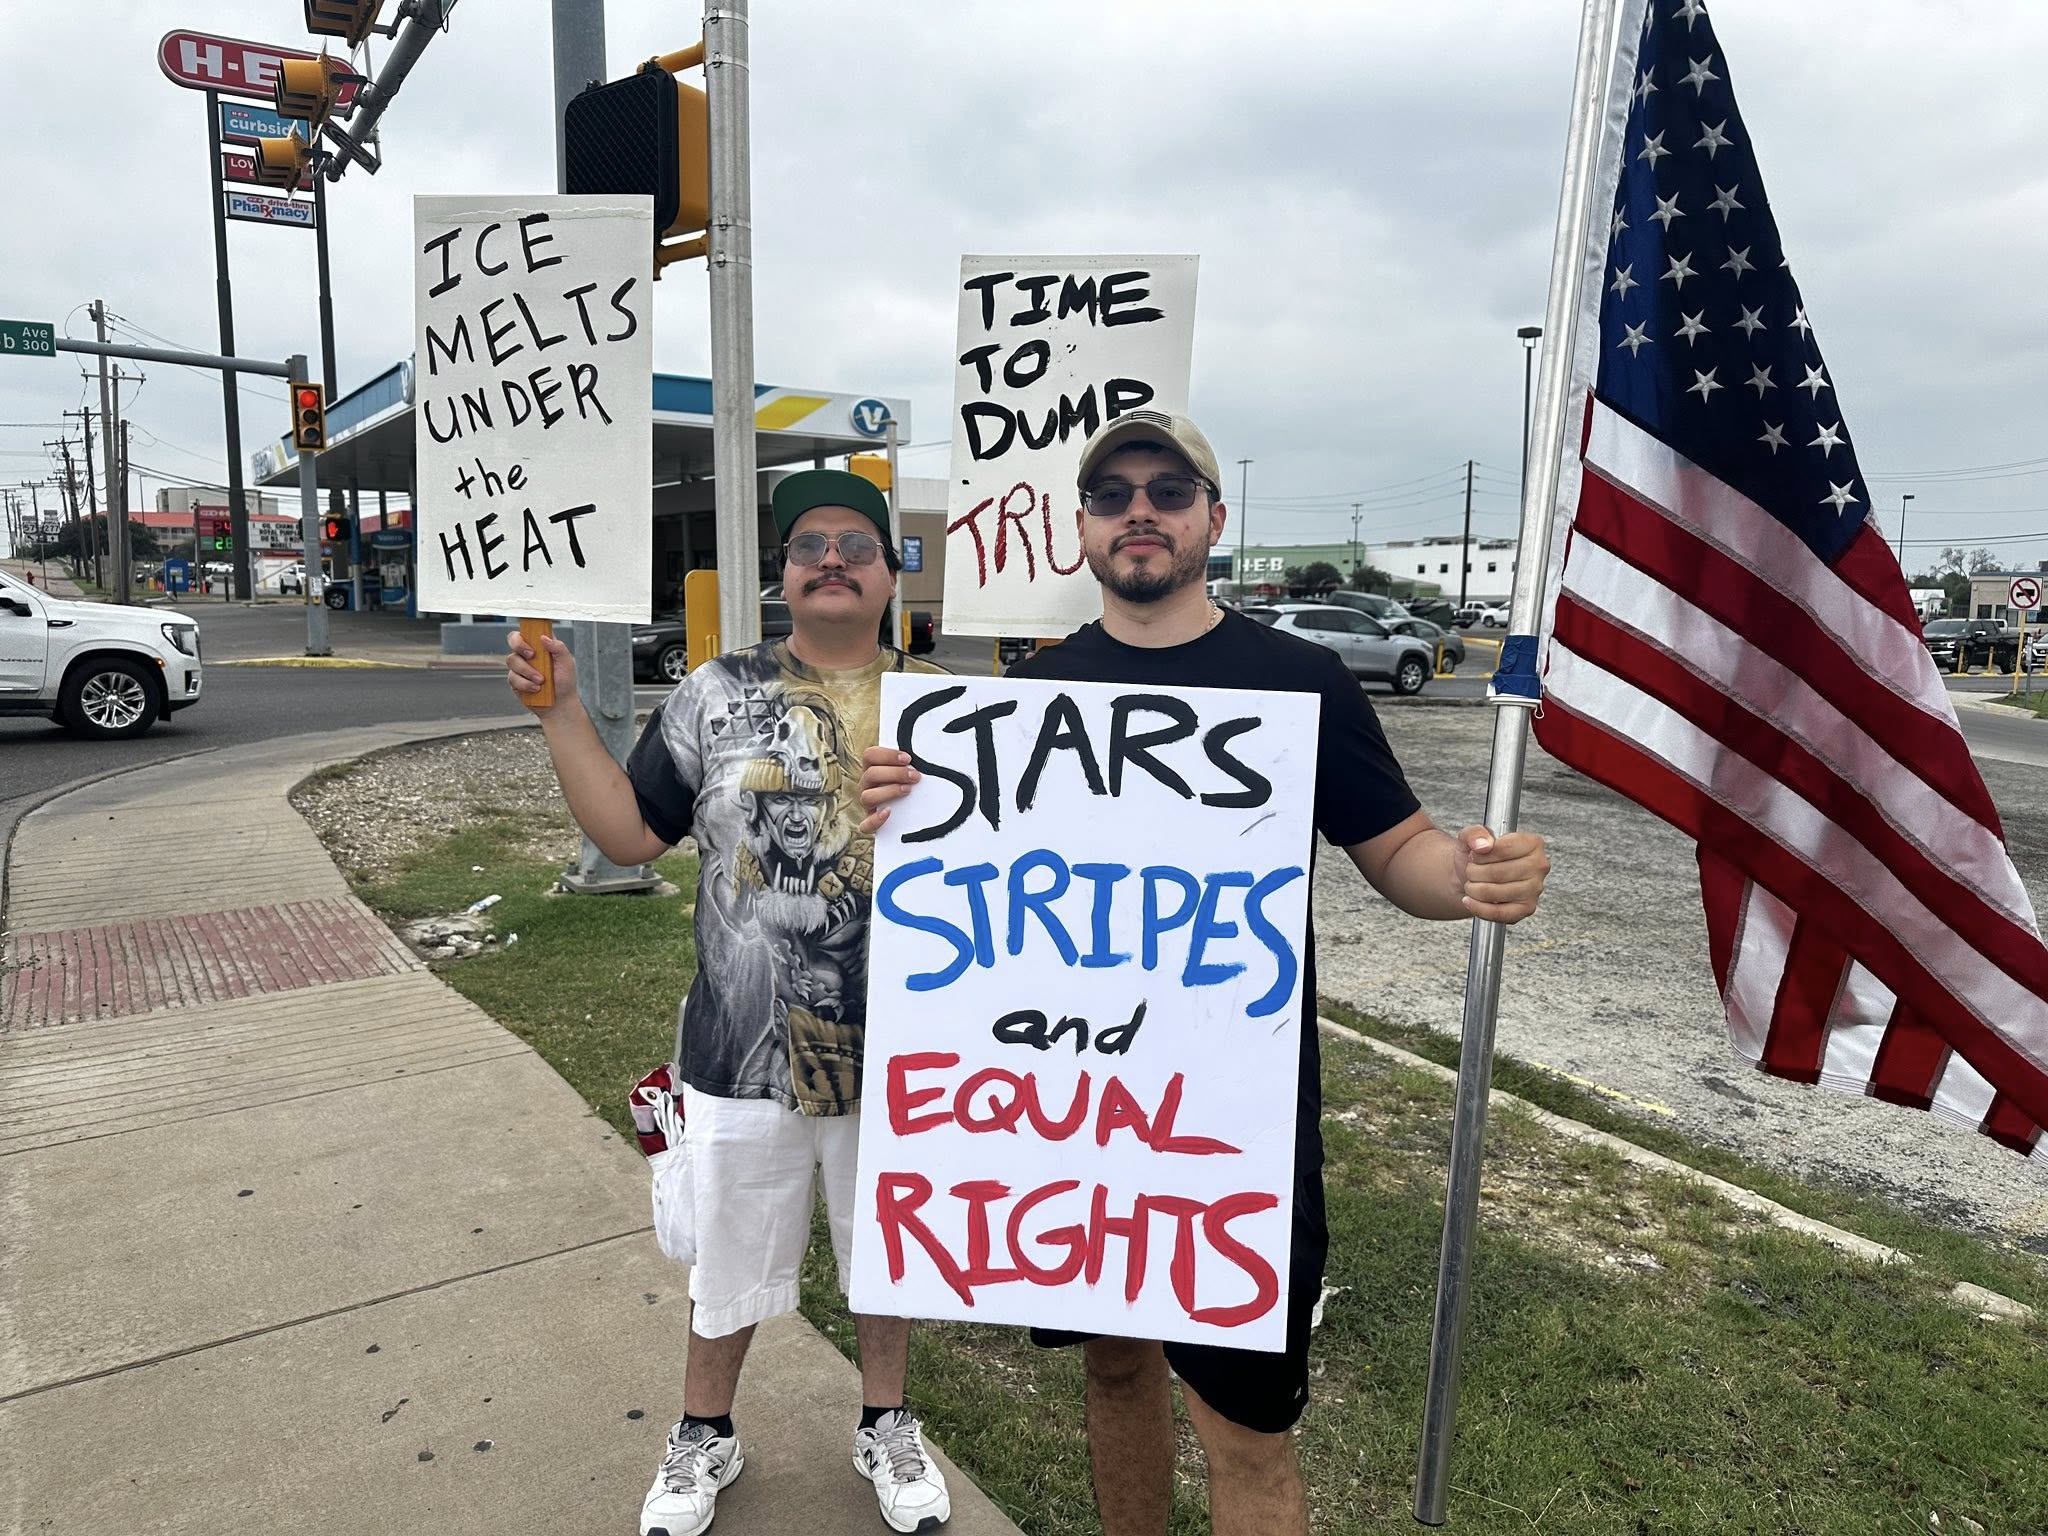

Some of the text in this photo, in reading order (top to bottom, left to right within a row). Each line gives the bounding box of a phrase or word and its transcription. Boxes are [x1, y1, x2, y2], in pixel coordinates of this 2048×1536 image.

[268, 199, 309, 210] drive-thru
[424, 213, 567, 298] ICE
[22, 326, 48, 339] Ave
[425, 277, 637, 375] MELTS
[963, 271, 1166, 331] TIME
[22, 339, 49, 352] 300
[959, 339, 1051, 395] TO
[424, 363, 613, 443] UNDER
[960, 378, 1155, 461] DUMP
[454, 457, 528, 500] the
[44, 524, 60, 532] 277
[438, 503, 597, 582] HEAT
[947, 481, 1086, 589] TRU
[897, 686, 1273, 843] STARS
[876, 849, 1305, 1018] STRIPES
[992, 998, 1148, 1056] and
[887, 1052, 1243, 1154] EQUAL
[876, 1171, 1280, 1328] RIGHTS
